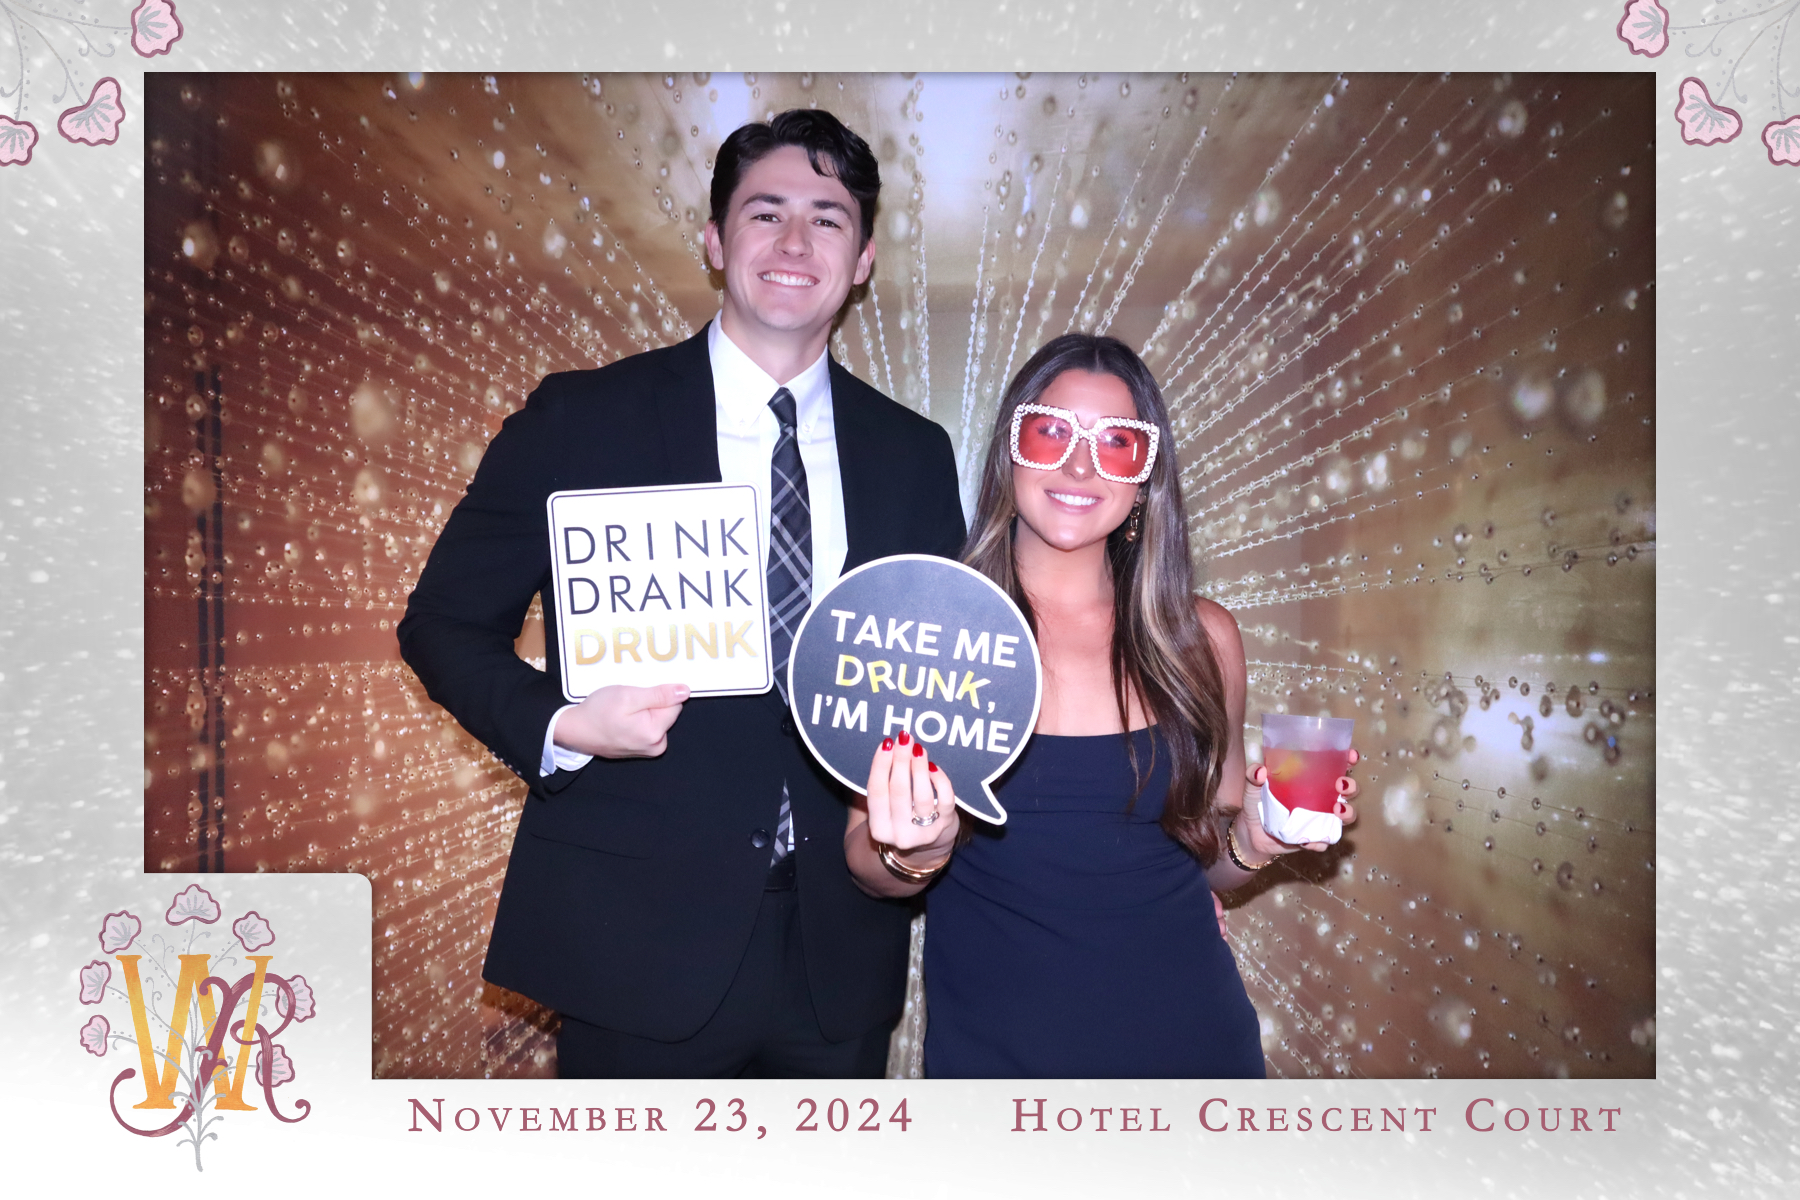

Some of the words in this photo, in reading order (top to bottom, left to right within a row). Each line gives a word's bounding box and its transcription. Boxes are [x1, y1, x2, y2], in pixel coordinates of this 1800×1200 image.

[563, 517, 749, 565] DRINK
[568, 568, 753, 615] DRANK
[573, 620, 759, 666] DRUNK
[830, 609, 942, 657] TAKE
[953, 628, 1019, 668] ME
[835, 653, 996, 714] DRUNK,
[811, 693, 868, 732] I'M
[883, 704, 1014, 754] HOME
